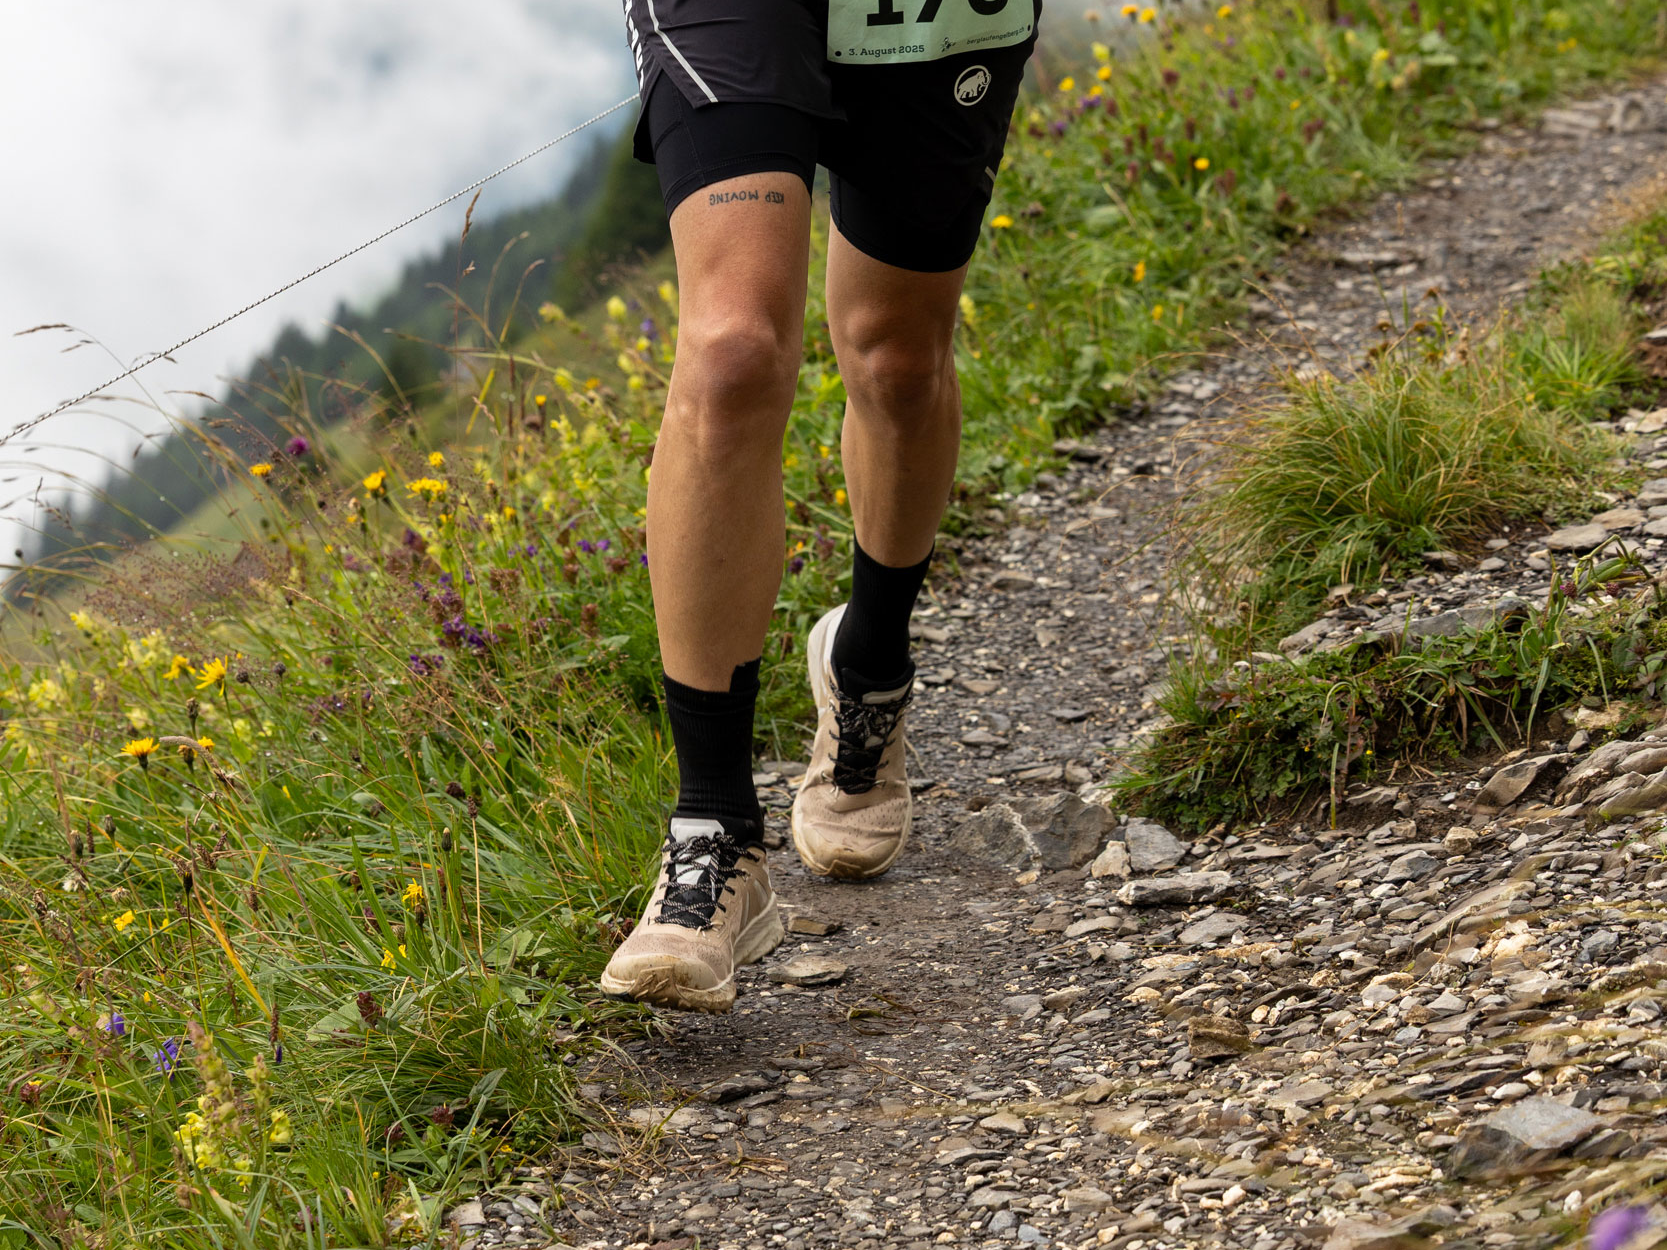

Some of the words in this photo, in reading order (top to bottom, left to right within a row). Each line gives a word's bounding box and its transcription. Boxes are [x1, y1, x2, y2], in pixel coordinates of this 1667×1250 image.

[860, 48, 897, 58] August
[899, 45, 925, 53] 2025
[709, 190, 759, 206] MOVING
[765, 191, 784, 205] KEEP
